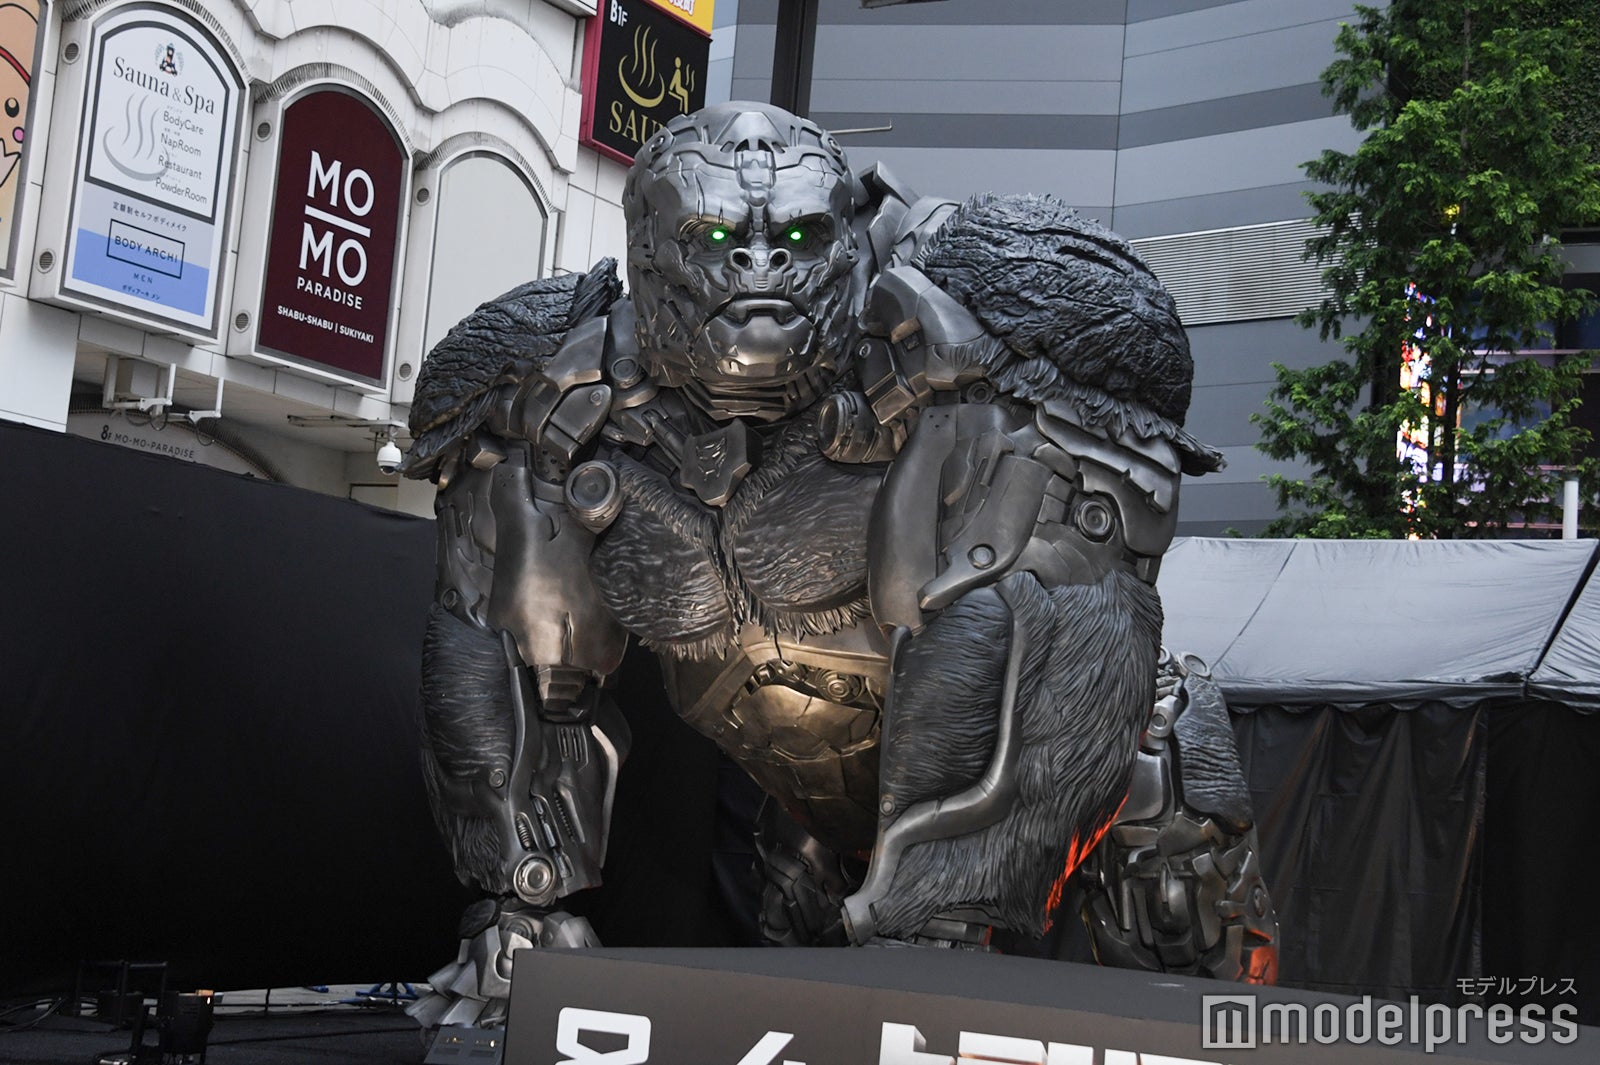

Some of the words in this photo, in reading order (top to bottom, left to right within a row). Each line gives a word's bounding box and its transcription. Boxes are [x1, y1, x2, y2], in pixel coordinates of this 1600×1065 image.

[610, 0, 628, 27] B1F
[114, 56, 169, 97] Sauna
[172, 87, 181, 102] &
[184, 85, 215, 114] Spa
[163, 110, 204, 135] BodyCare
[610, 100, 664, 145] SAU
[160, 132, 202, 156] NapRoom
[158, 154, 202, 179] Restaurant
[155, 176, 207, 204] PowderRoom
[307, 150, 374, 217] MO
[114, 235, 142, 251] BODY
[145, 246, 178, 263] ARCHI
[299, 221, 367, 286] MO
[133, 273, 153, 284] MEN
[297, 276, 363, 310] PARADISE
[277, 305, 333, 331] SHABU-SHABU
[339, 325, 374, 343] SUKIYAKI
